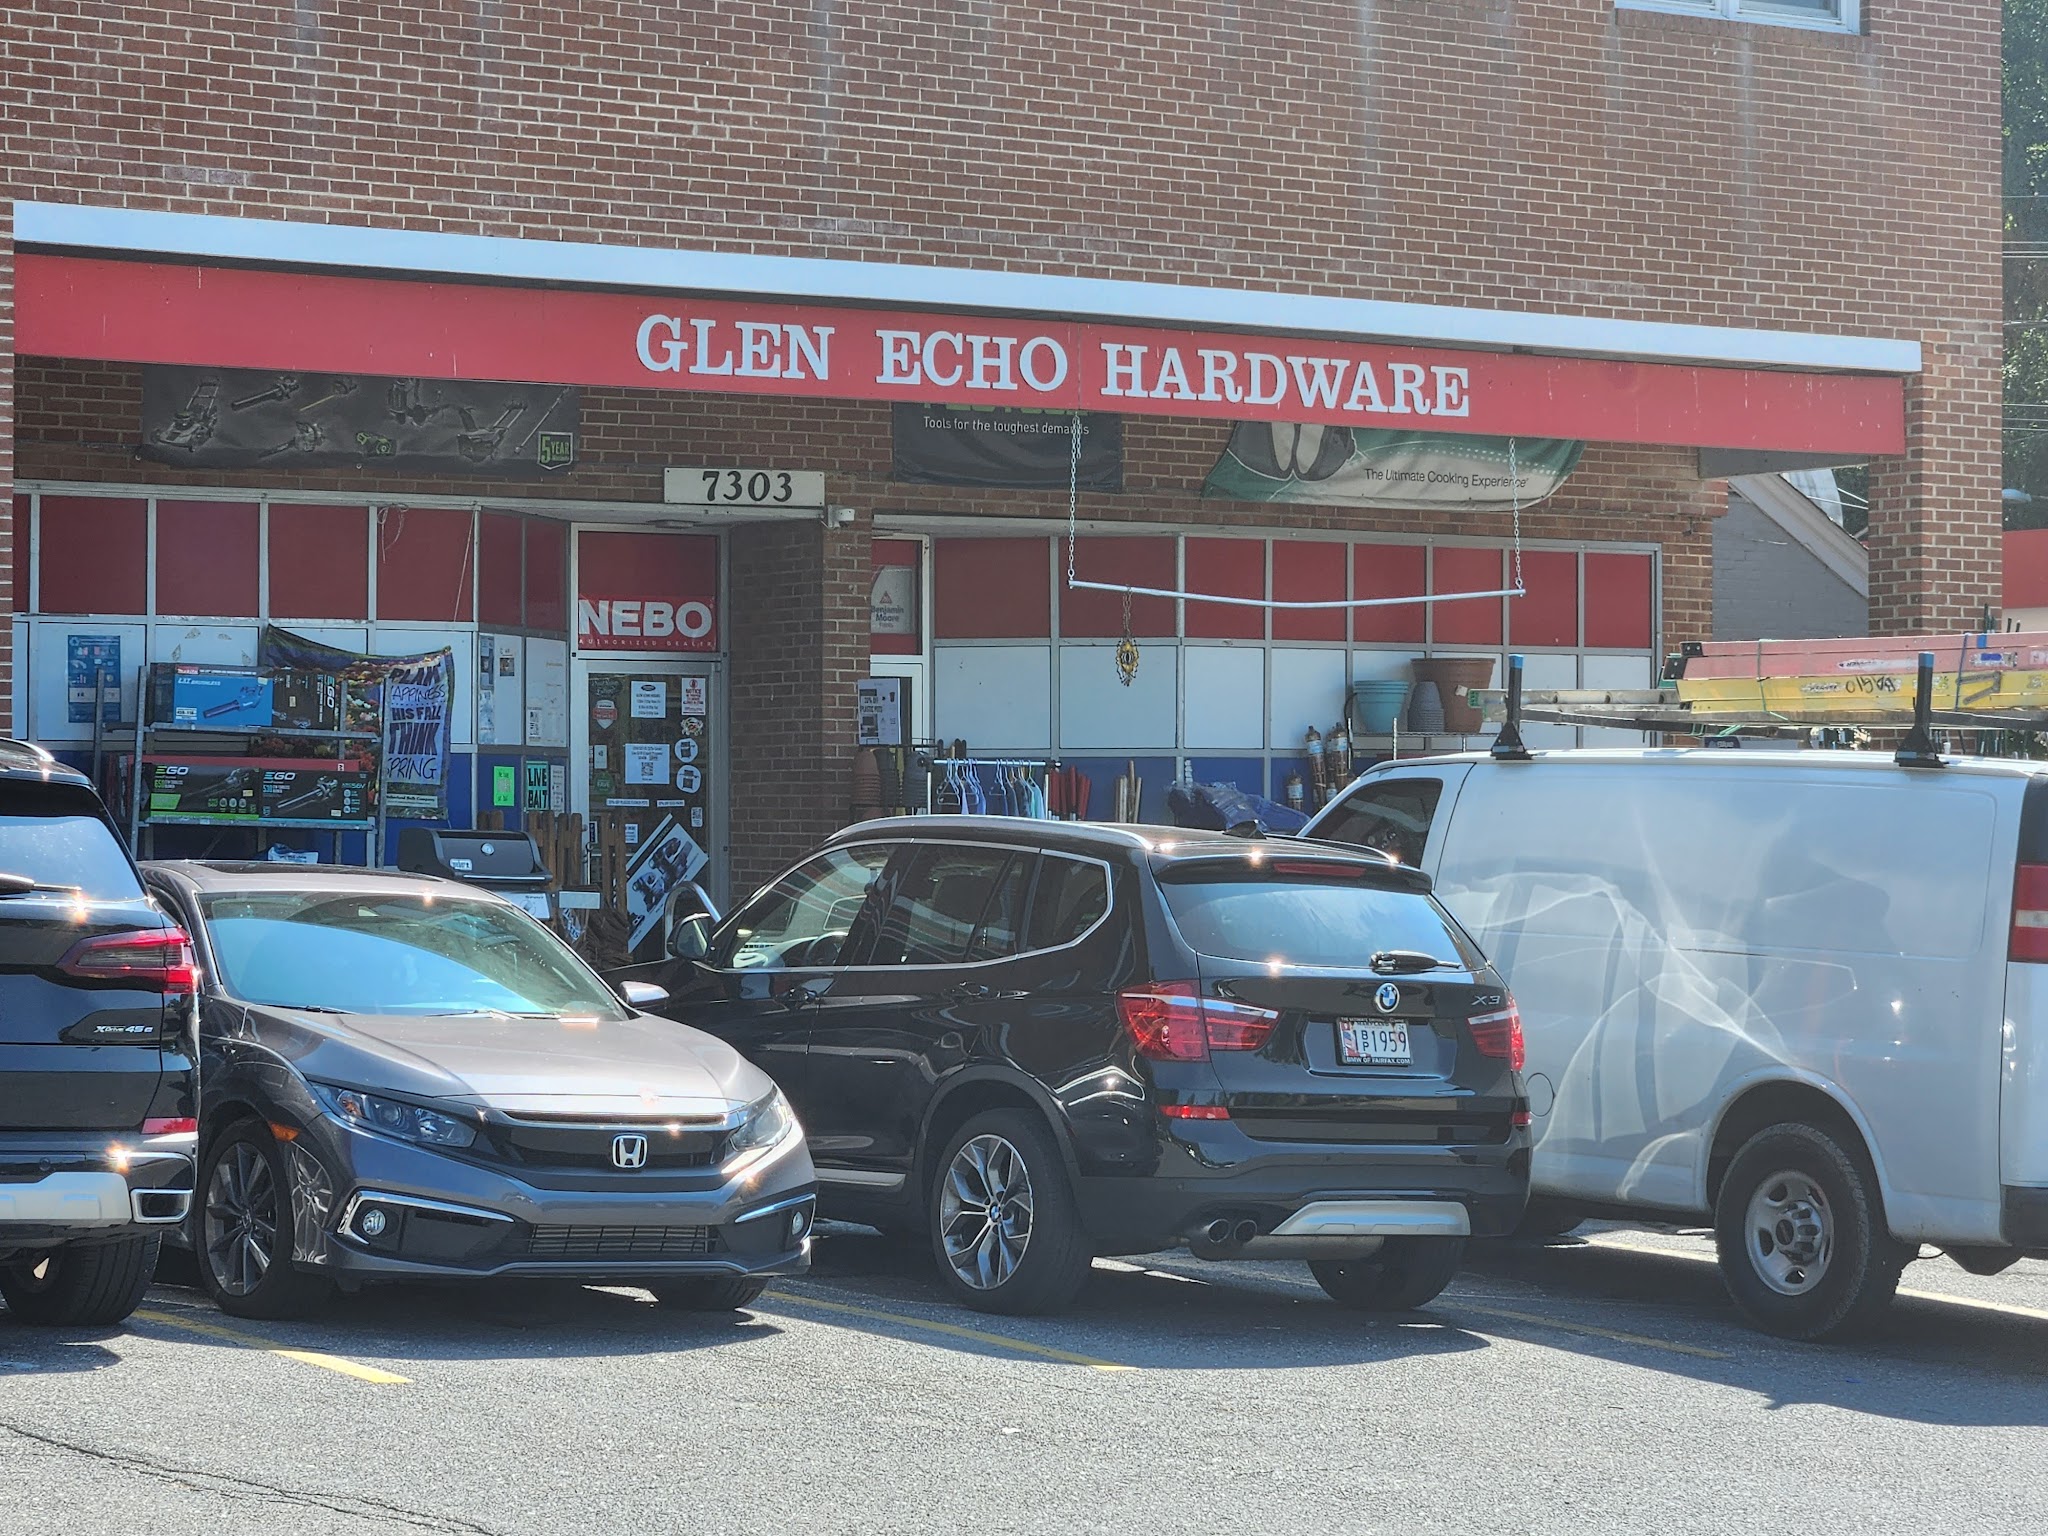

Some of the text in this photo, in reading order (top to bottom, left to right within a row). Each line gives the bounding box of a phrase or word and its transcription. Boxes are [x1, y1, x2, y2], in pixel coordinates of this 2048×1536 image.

[636, 314, 1469, 417] GLEN ECHO HARDWARE
[923, 416, 952, 429] Tools
[954, 418, 969, 430] for
[972, 420, 990, 431] the
[993, 422, 1039, 435] toughest
[541, 436, 551, 464] 5
[551, 442, 570, 455] YEAR
[702, 470, 792, 502] 7303
[1365, 468, 1383, 480] The
[1385, 470, 1425, 482] Ultimate
[1427, 470, 1469, 488] Cooking
[578, 599, 712, 638] NEBO
[876, 613, 899, 622] Moore
[327, 675, 335, 708] EGO
[390, 684, 446, 702] APPINESS
[416, 705, 442, 720] FALL
[388, 722, 440, 756] THINK
[155, 766, 189, 775] EGO
[263, 772, 296, 780] EGO
[528, 768, 547, 787] LIVE
[528, 790, 548, 809] BAIT
[1471, 995, 1500, 1006] X3
